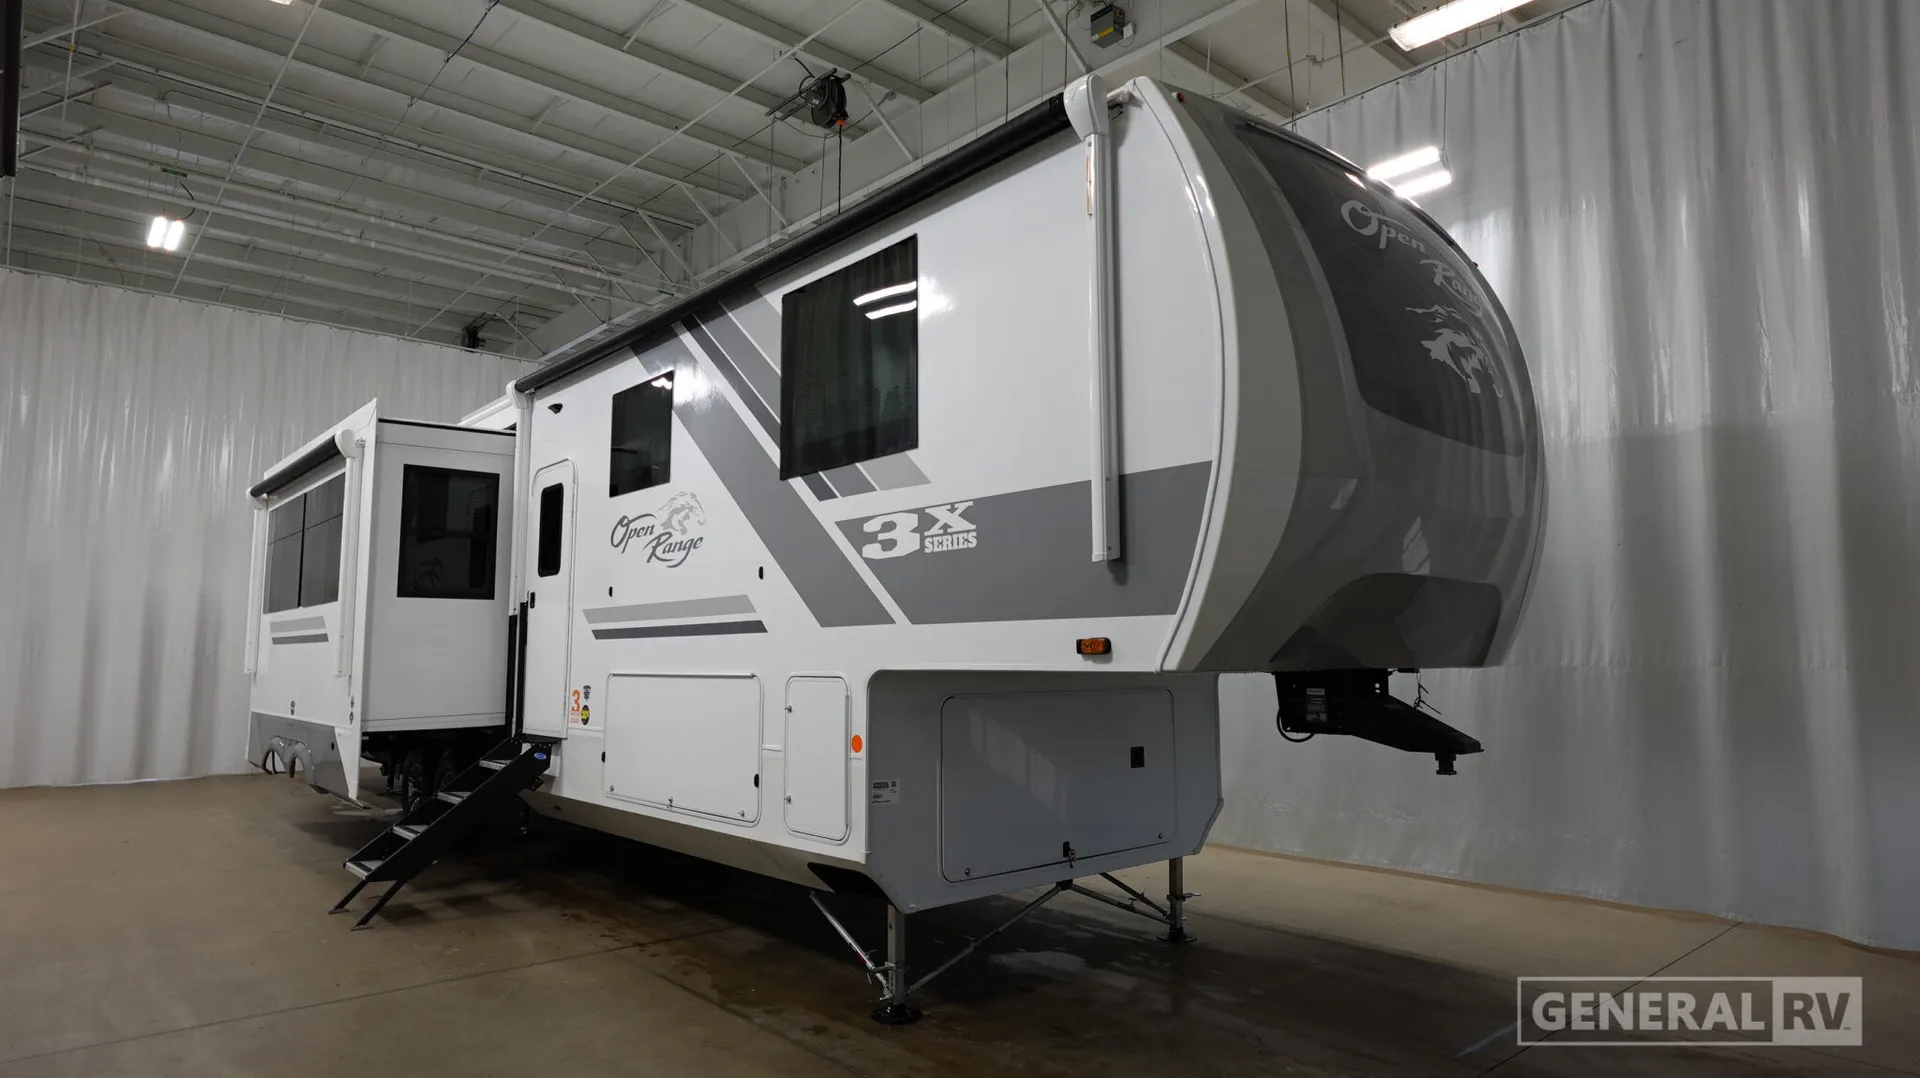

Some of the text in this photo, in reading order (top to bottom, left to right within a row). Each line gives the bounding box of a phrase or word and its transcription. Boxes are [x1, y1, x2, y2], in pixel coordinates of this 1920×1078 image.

[1340, 200, 1428, 254] Open
[610, 513, 658, 554] Open
[642, 531, 704, 568] Range
[924, 531, 978, 554] SERIES
